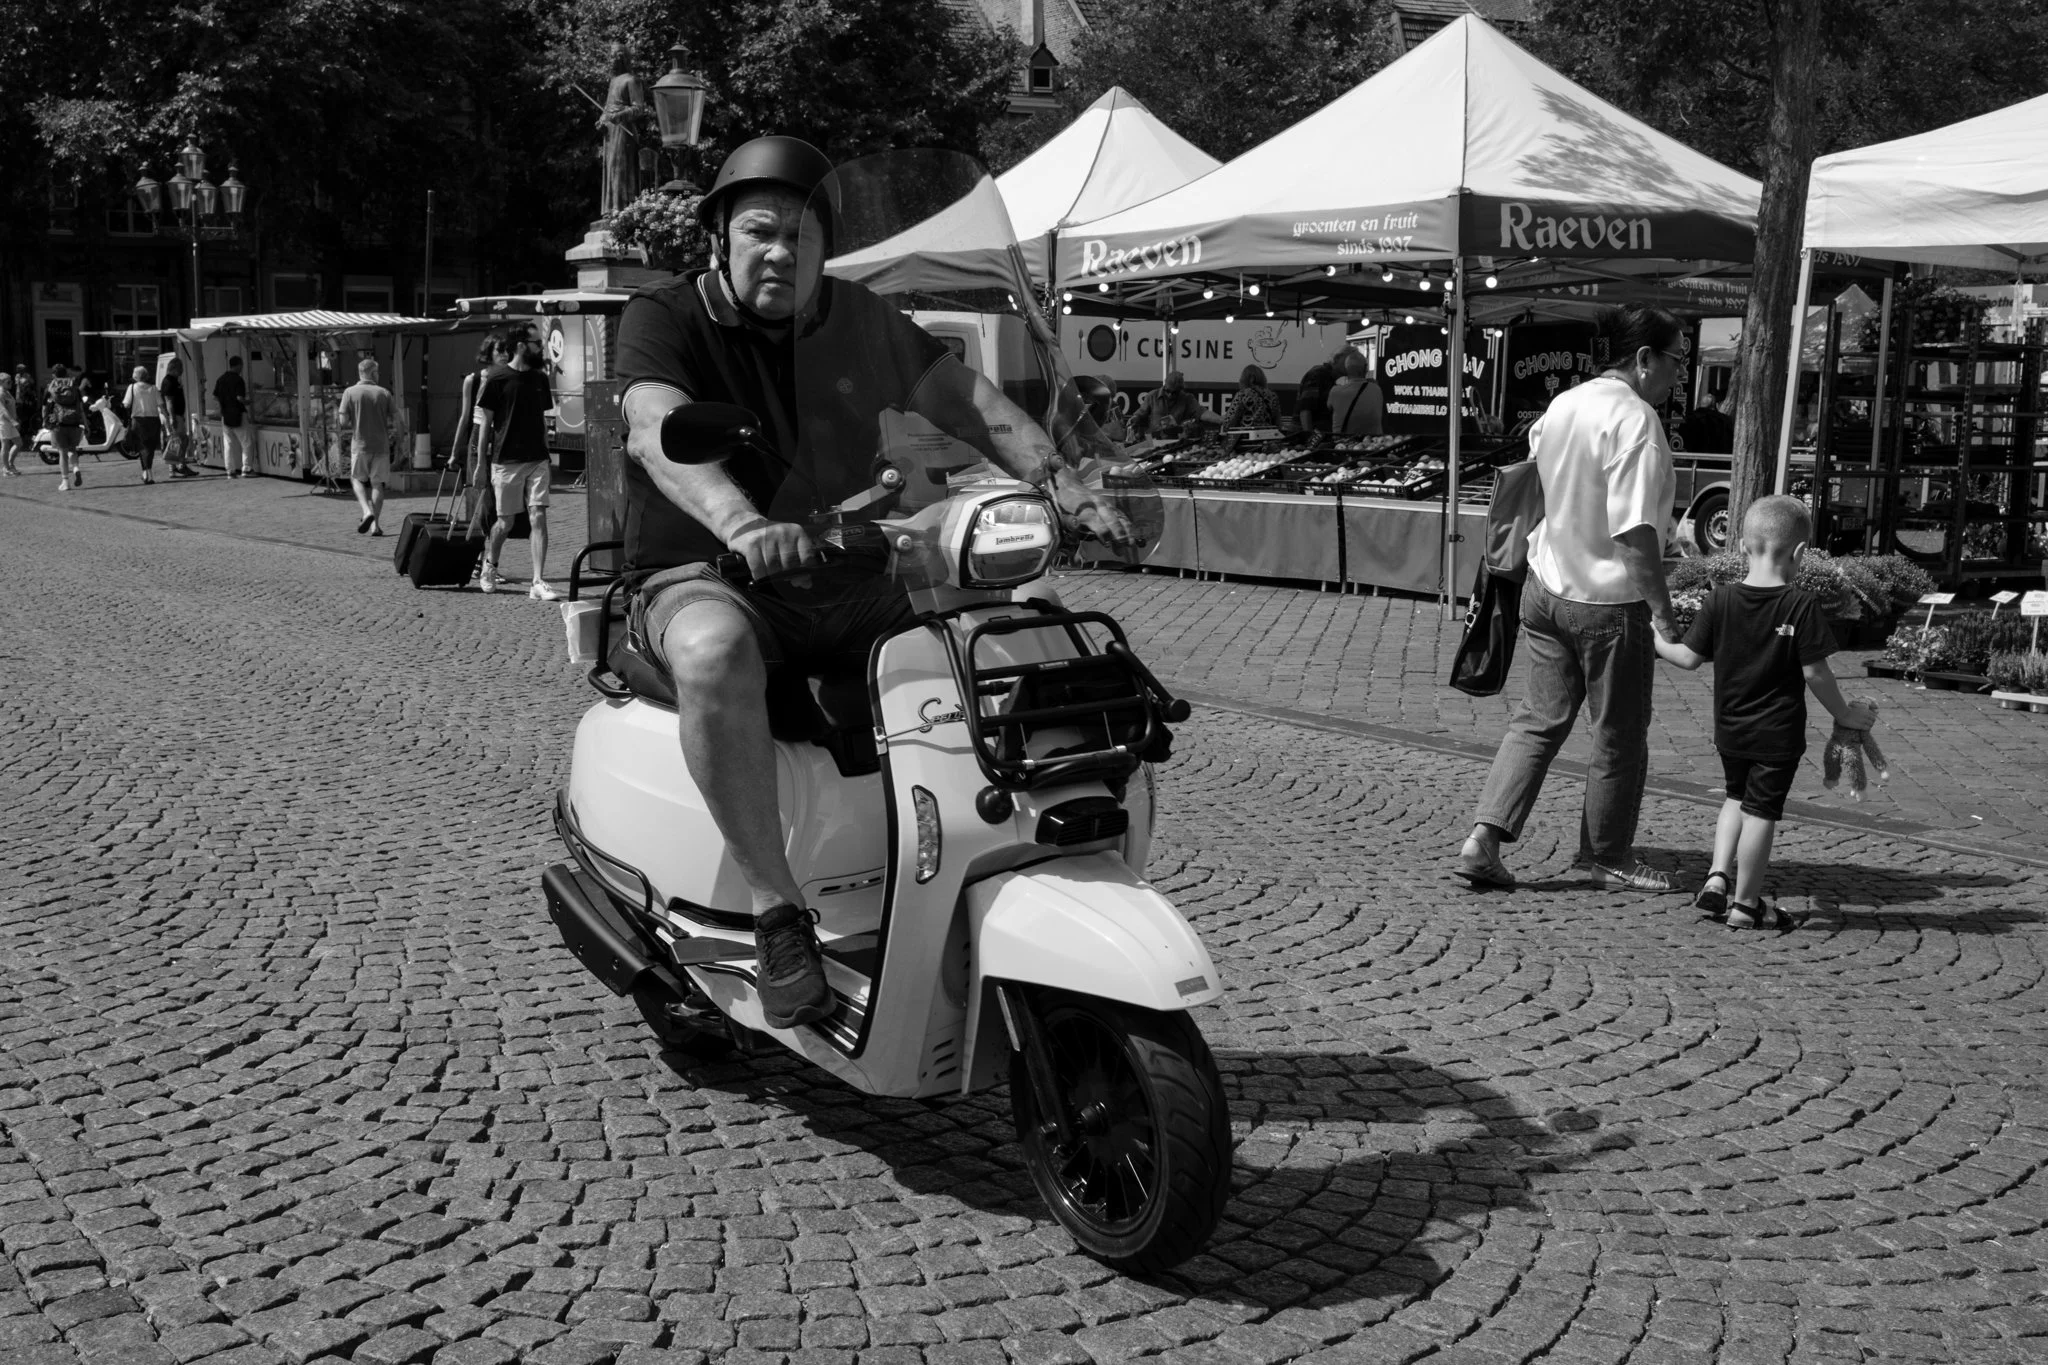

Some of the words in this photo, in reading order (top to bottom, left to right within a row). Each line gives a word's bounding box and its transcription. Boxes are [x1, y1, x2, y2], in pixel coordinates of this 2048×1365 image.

[1292, 217, 1357, 238] groenten
[1360, 217, 1379, 231] en
[1383, 211, 1419, 230] fruit
[1499, 202, 1653, 251] Raeven
[1080, 234, 1202, 278] Raeven
[1336, 238, 1375, 256] sinds
[1378, 235, 1414, 253] 1907
[1385, 348, 1443, 378] CHONG
[1514, 351, 1573, 380] CHONG
[1393, 385, 1414, 396] WOK
[1413, 385, 1421, 396] &
